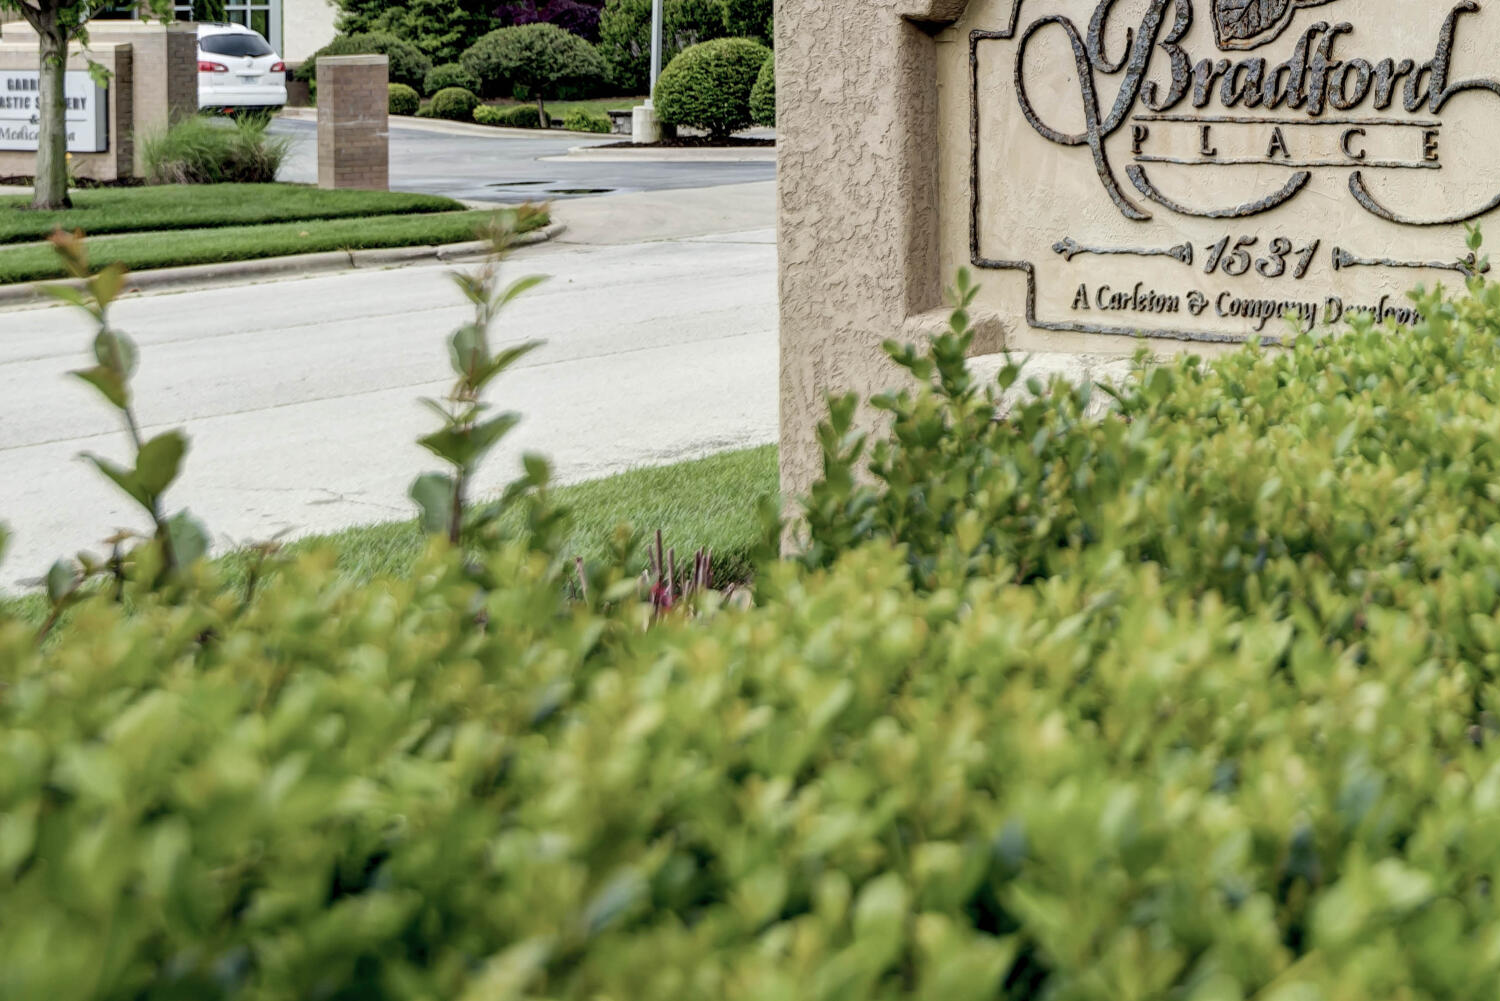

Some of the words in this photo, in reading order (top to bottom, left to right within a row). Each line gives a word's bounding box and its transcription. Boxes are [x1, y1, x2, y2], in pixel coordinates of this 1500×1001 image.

[7, 78, 40, 91] GARR
[35, 96, 86, 110] SERY
[1130, 123, 1440, 162] PLACE
[1203, 234, 1321, 280] 1531
[1071, 282, 1091, 311] A
[1095, 281, 1180, 313] Carleton
[1187, 289, 1209, 316] &
